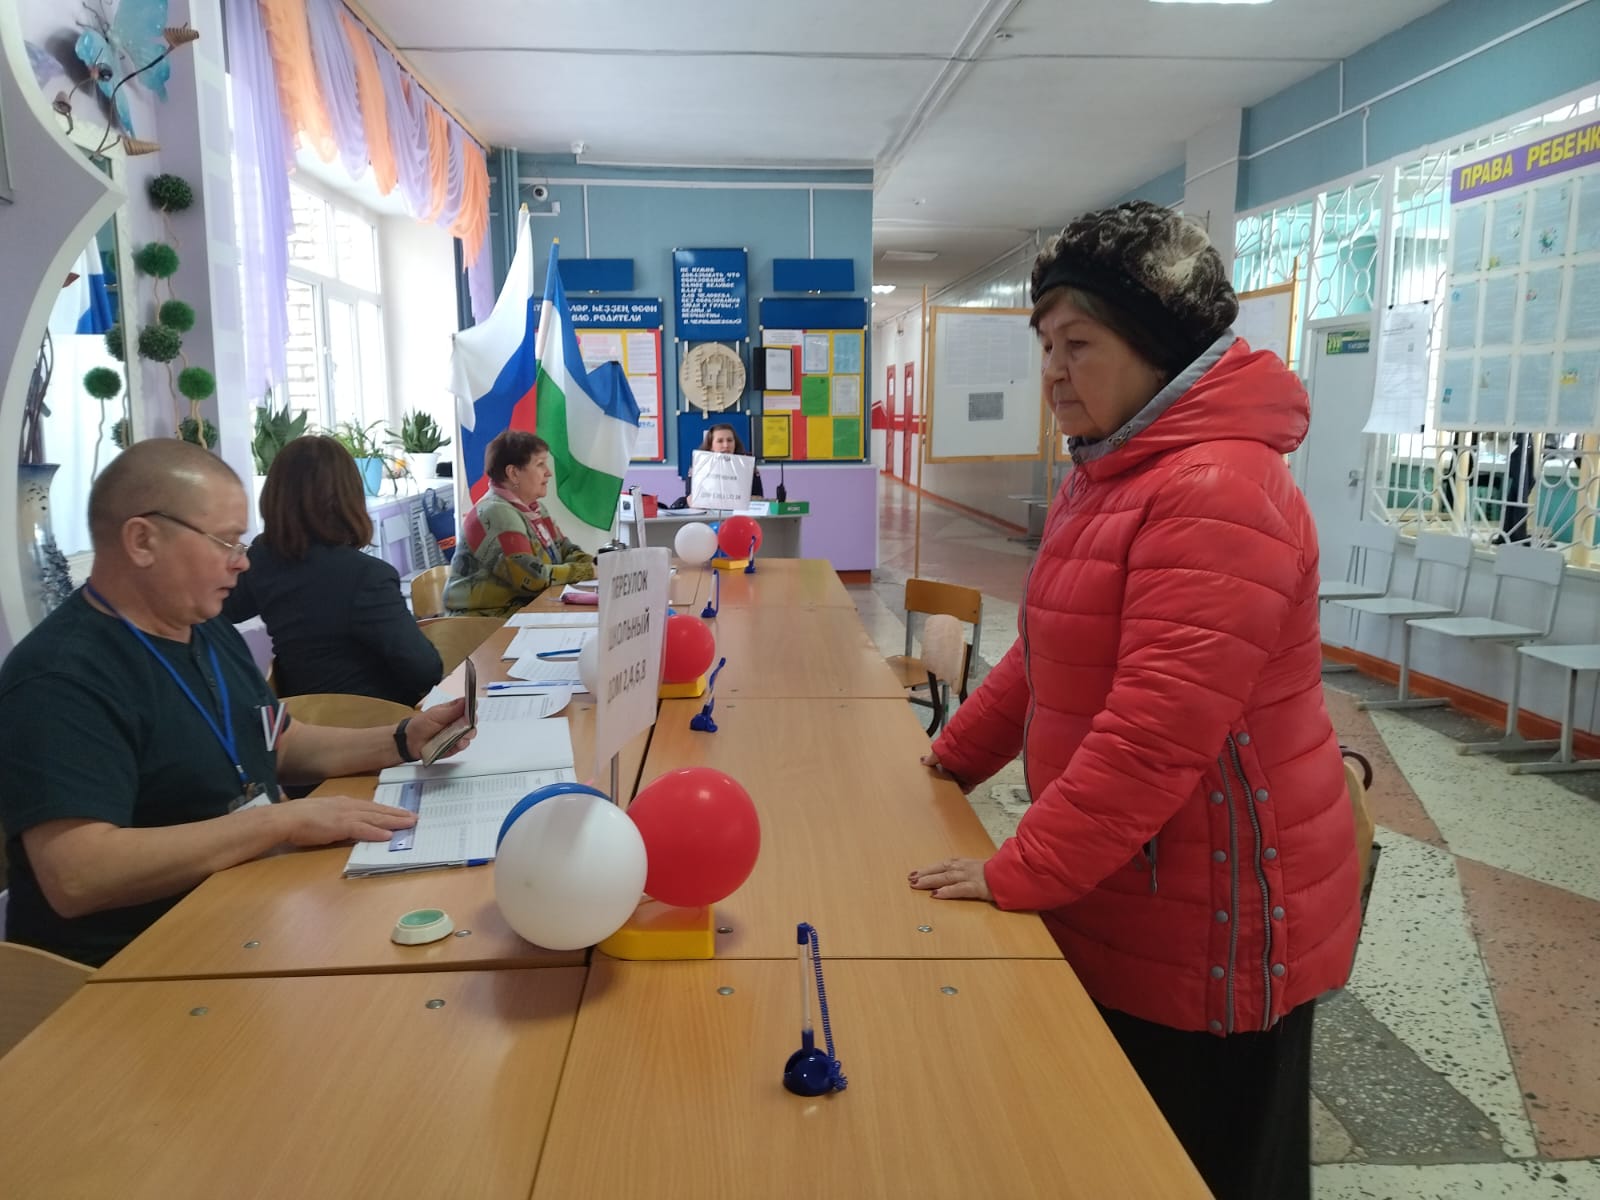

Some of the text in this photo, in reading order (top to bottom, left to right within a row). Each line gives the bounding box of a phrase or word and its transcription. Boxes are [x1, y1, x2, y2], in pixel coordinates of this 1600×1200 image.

[1460, 125, 1600, 191] ПРАВА РЕБЕНК
[593, 313, 642, 322] РОДИТЕЛИ
